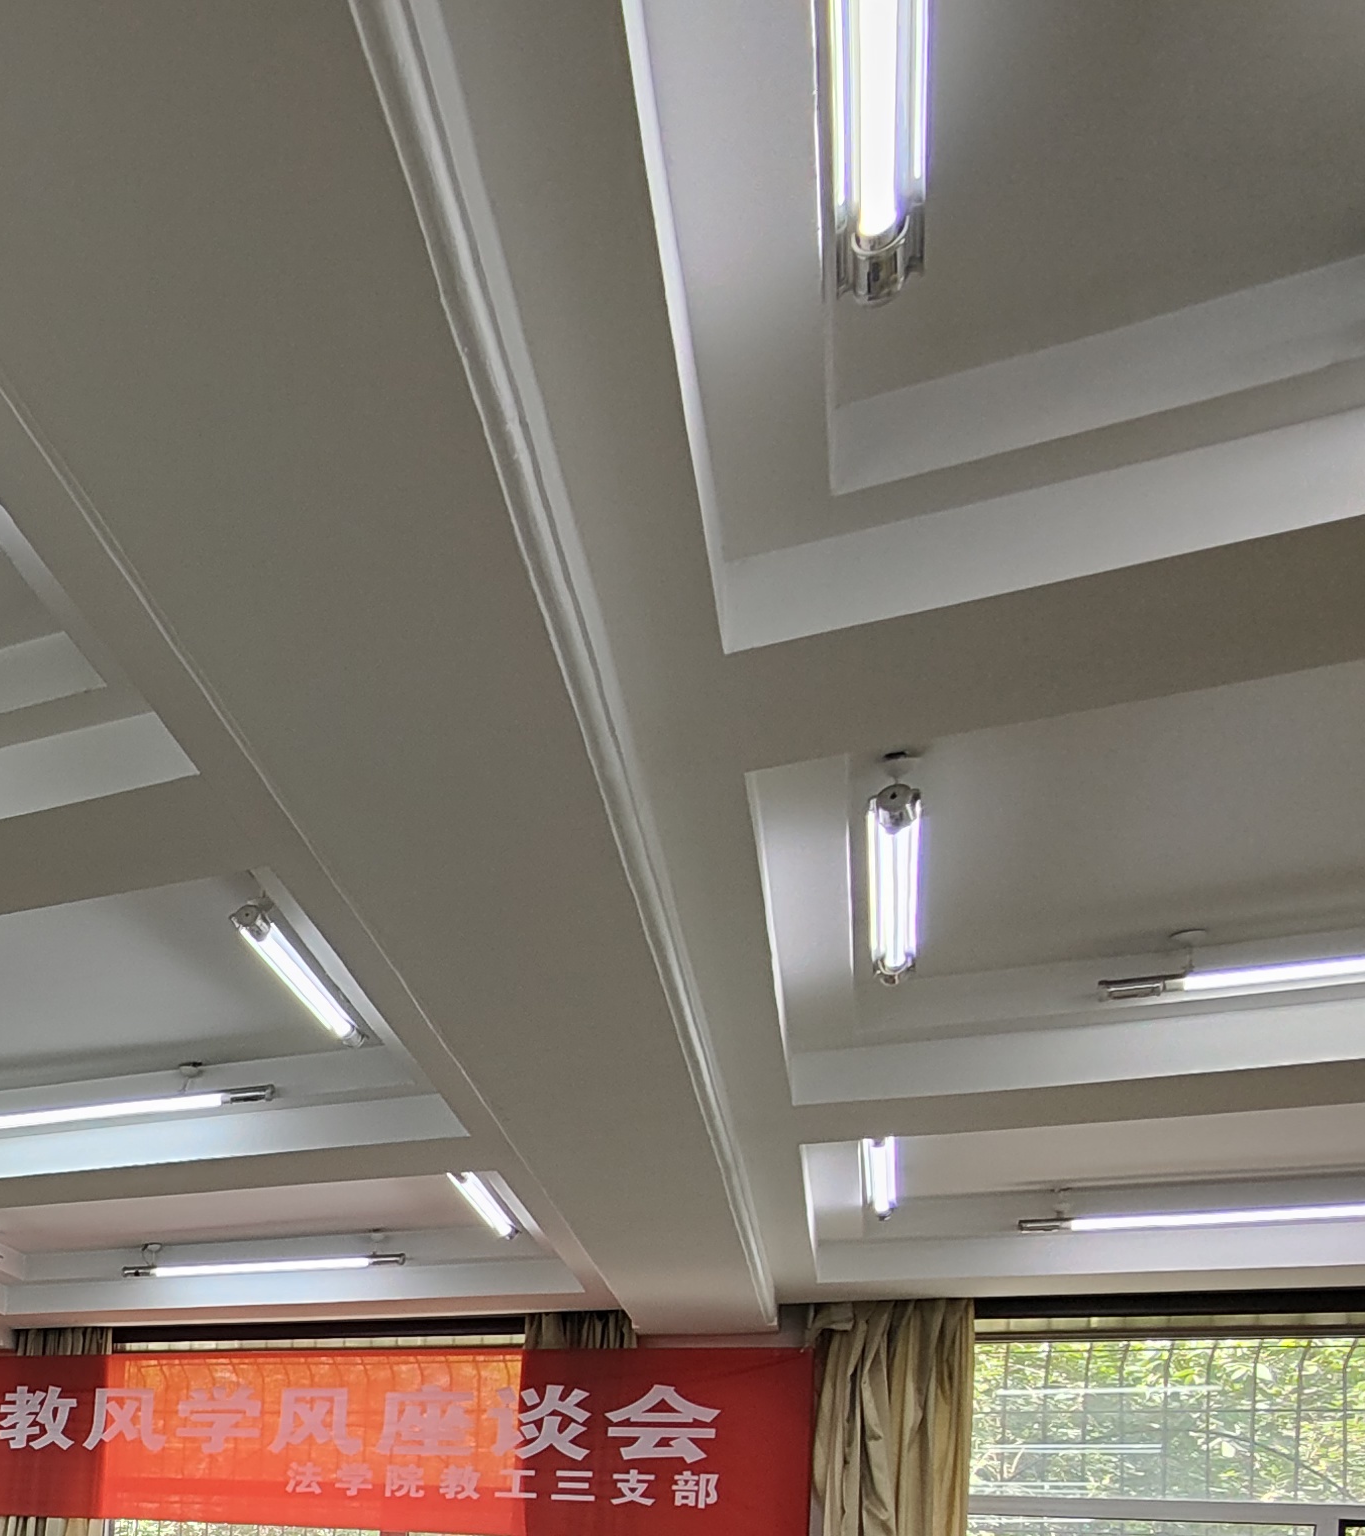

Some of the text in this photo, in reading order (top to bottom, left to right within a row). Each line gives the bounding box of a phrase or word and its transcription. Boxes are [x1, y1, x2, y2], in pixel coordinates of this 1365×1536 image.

[285, 1462, 720, 1510] 法学院教工三支部
